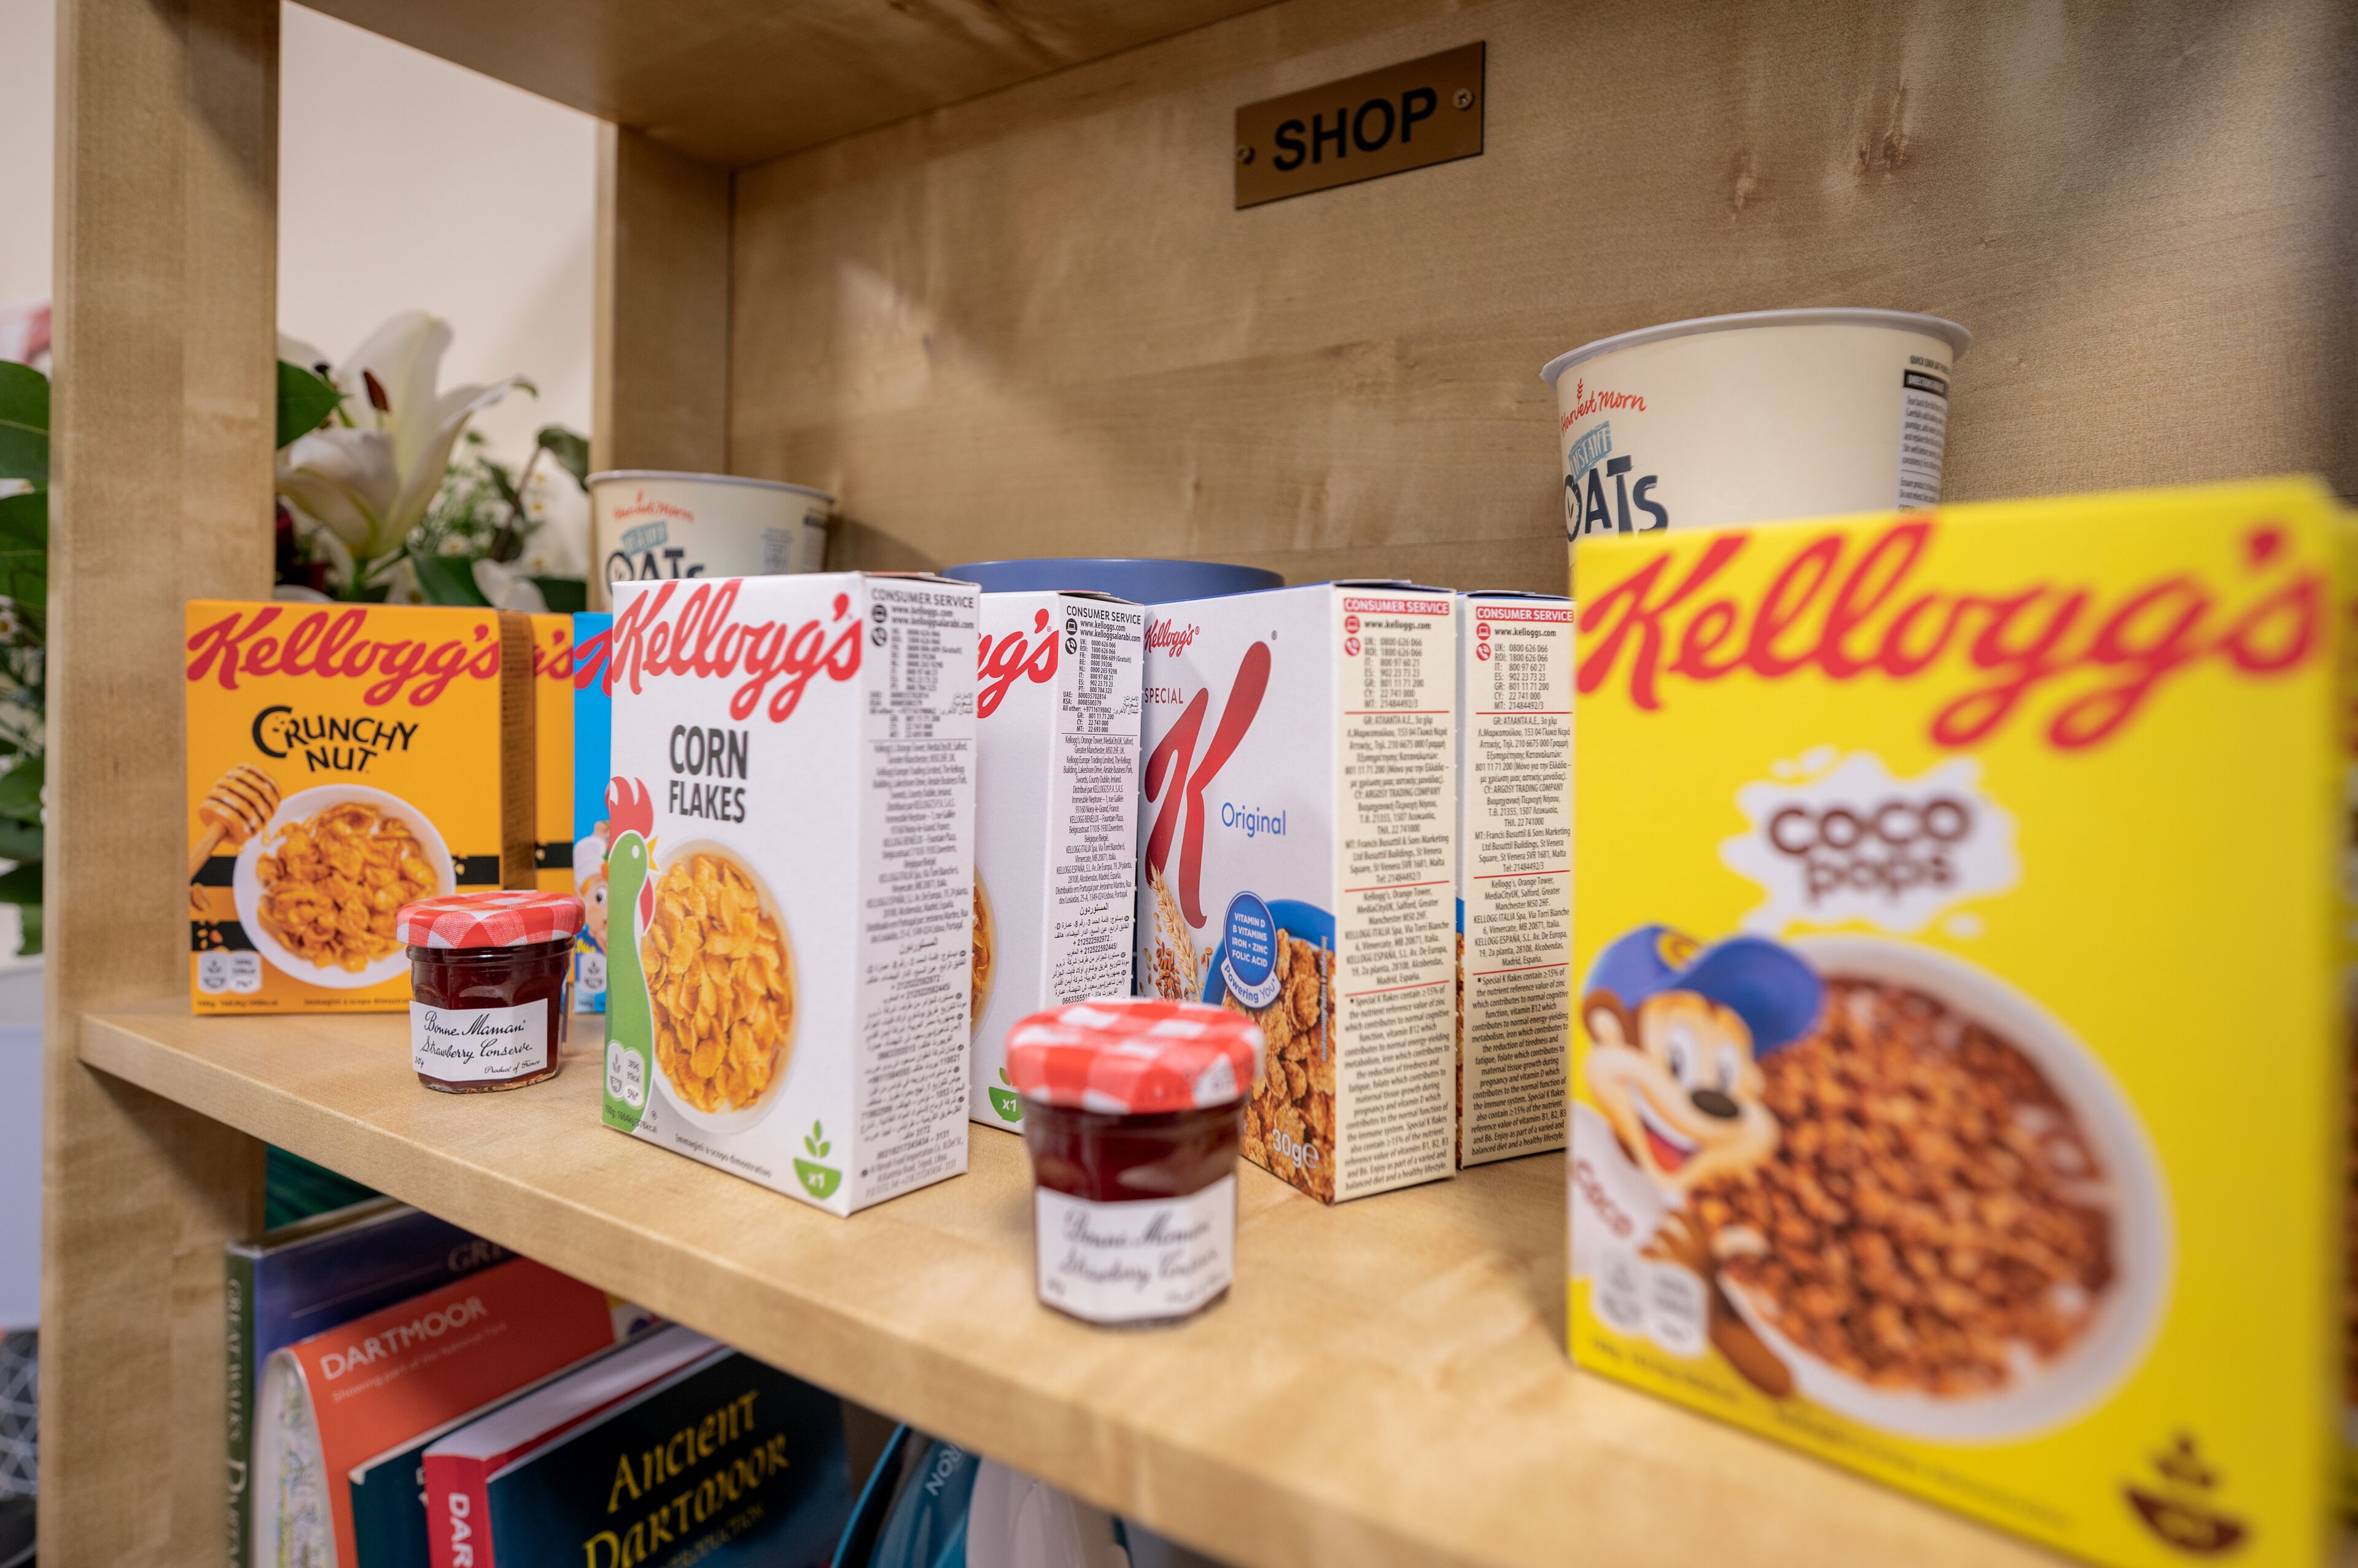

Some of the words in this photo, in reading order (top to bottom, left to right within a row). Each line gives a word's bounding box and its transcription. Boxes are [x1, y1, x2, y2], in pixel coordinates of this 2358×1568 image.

[1273, 87, 1438, 171] SHOP
[1560, 394, 1597, 436] Harvest
[1598, 390, 1647, 412] Morn
[1569, 426, 1611, 476] INSTANT
[871, 588, 931, 605] CONSUMER
[933, 594, 974, 608] SERVICE
[1345, 599, 1405, 613] CONSUMER
[1406, 602, 1449, 615] SERVICE
[1066, 606, 1109, 620] CONSUMER
[1111, 612, 1141, 624] SERVICE
[1476, 608, 1532, 620] CONSUMER
[1534, 610, 1573, 621] SERVICE
[1080, 620, 1126, 632] www.kelloggs.com
[1364, 619, 1431, 631] www.kelloggs.com
[1494, 628, 1557, 638] www.kelloggs.com
[1080, 629, 1140, 642] www.kelloggsalarabi.com
[1145, 619, 1194, 658] Kellogg's
[1573, 516, 2331, 755] Kellogg's
[187, 607, 500, 706] Kellogg's
[612, 579, 862, 723] Kellogg's
[1494, 672, 1503, 681] ES:
[1145, 688, 1183, 704] SPECIAL
[252, 705, 419, 758] CRUNCHY
[306, 748, 378, 773] NUT
[669, 724, 749, 778] CORN
[1144, 640, 1271, 929] K
[1484, 785, 1492, 794] CY:
[1493, 784, 1515, 793] ARGOSY
[1516, 783, 1538, 793] TRADING
[1539, 783, 1563, 792] COMPANY
[668, 779, 746, 824] FLAKES
[1221, 802, 1287, 838] Original
[1767, 793, 1975, 857] COCO
[1474, 831, 1485, 840] MT:
[1506, 829, 1526, 838] Busuttil
[1545, 828, 1570, 837] Marketing
[1503, 864, 1512, 872] Tel:
[1514, 862, 1544, 871] 21484492/3
[1804, 857, 1956, 906] pops
[1079, 903, 1108, 915] المستوردون
[1473, 914, 1498, 924] KELLOGG
[1549, 909, 1570, 918] Bianche
[1234, 913, 1259, 926] VITAMIN
[1238, 926, 1267, 942] VITAMINS
[1231, 937, 1247, 948] IRON
[1252, 942, 1267, 954] ZINC
[1232, 950, 1250, 962] FOLIC
[1251, 957, 1267, 968] ACID
[1224, 964, 1259, 1003] Powering
[1486, 986, 1509, 995] nutrient
[1509, 984, 1534, 993] reference
[1535, 982, 1549, 991] value
[424, 1011, 459, 1036] Bonne
[462, 1014, 524, 1035] Maman
[420, 1036, 474, 1064] Strawberry
[480, 1039, 532, 1057] Conserve
[512, 1063, 519, 1073] of
[1001, 1099, 1018, 1112] x1
[675, 1134, 704, 1152] Immagini
[709, 1149, 728, 1162] scopo
[1471, 1146, 1495, 1155] balanced
[1523, 1136, 1543, 1147] healthy
[1543, 1133, 1565, 1143] lifestyle.
[807, 1171, 825, 1189] x1
[320, 1297, 488, 1380] DARTMOOR
